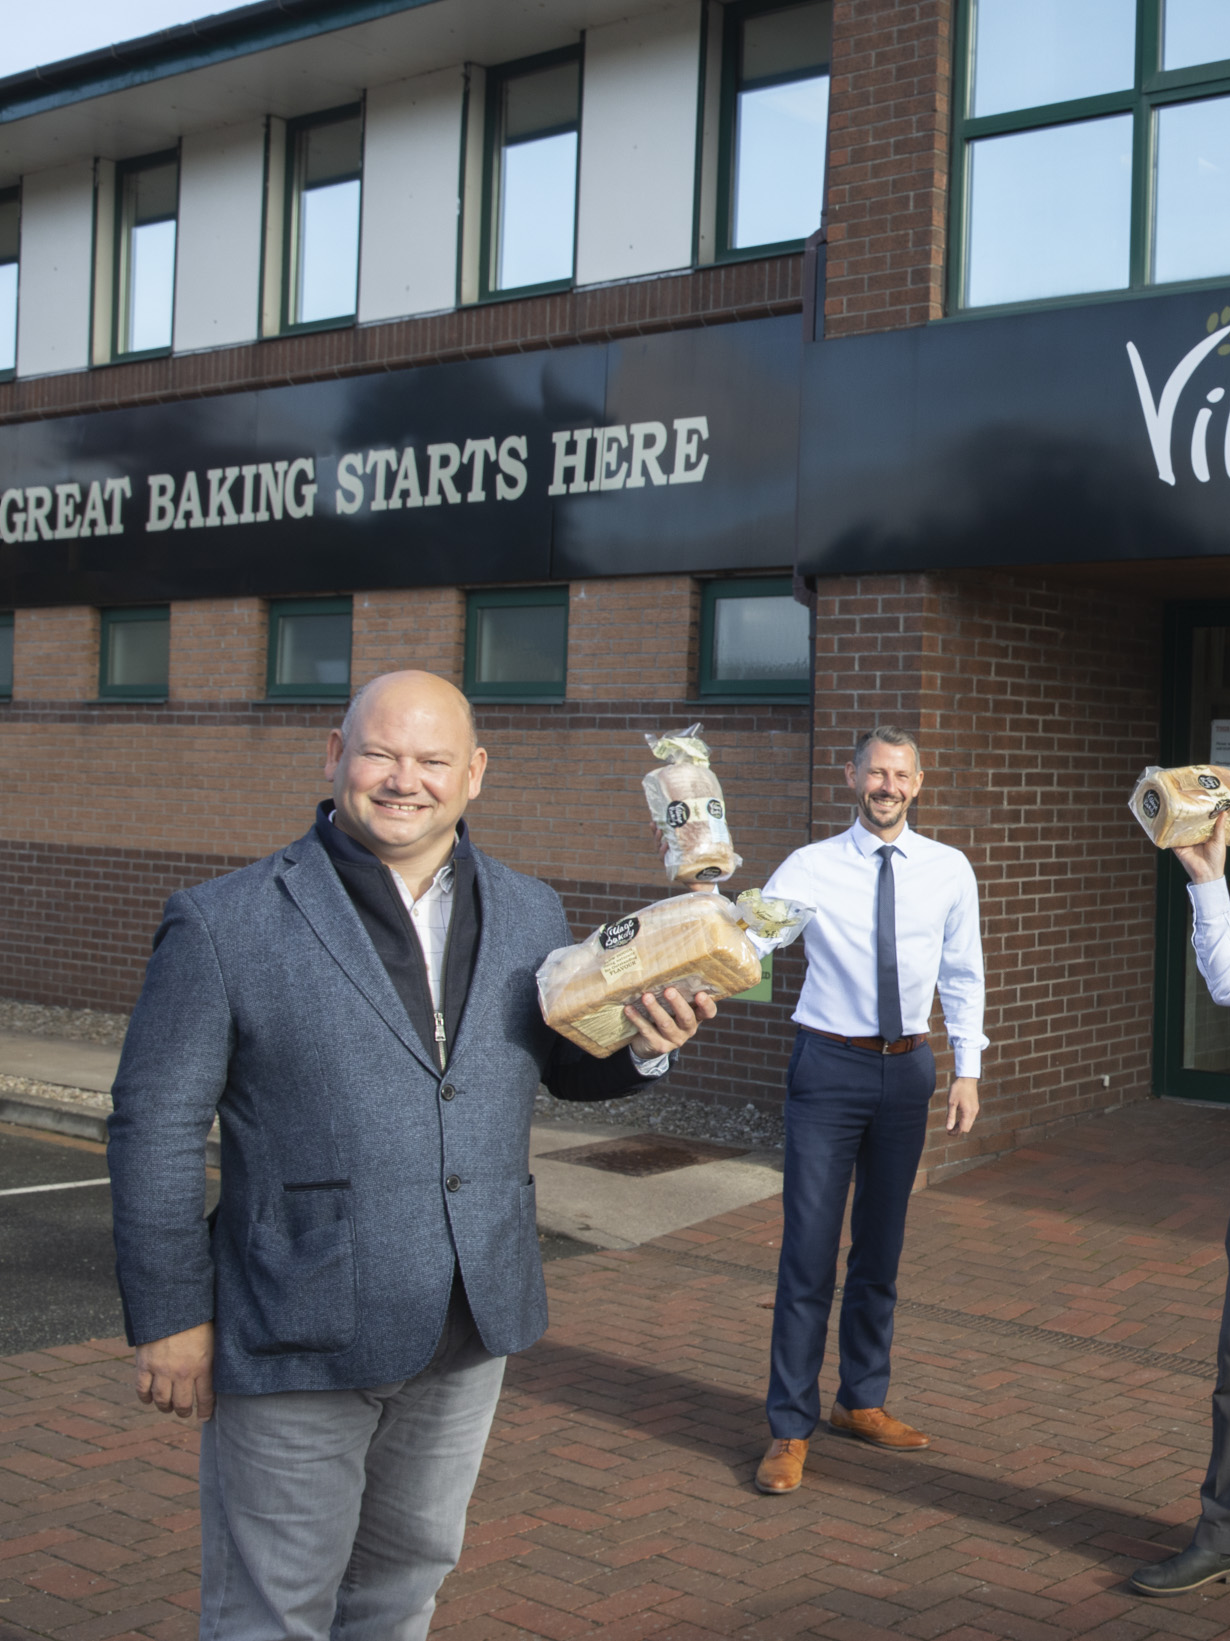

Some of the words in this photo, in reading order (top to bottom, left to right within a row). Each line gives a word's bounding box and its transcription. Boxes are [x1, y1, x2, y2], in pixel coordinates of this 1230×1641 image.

[0, 477, 132, 543] GREAT
[146, 457, 318, 532] BAKING
[335, 436, 529, 515] STARTS
[548, 416, 710, 496] HERE
